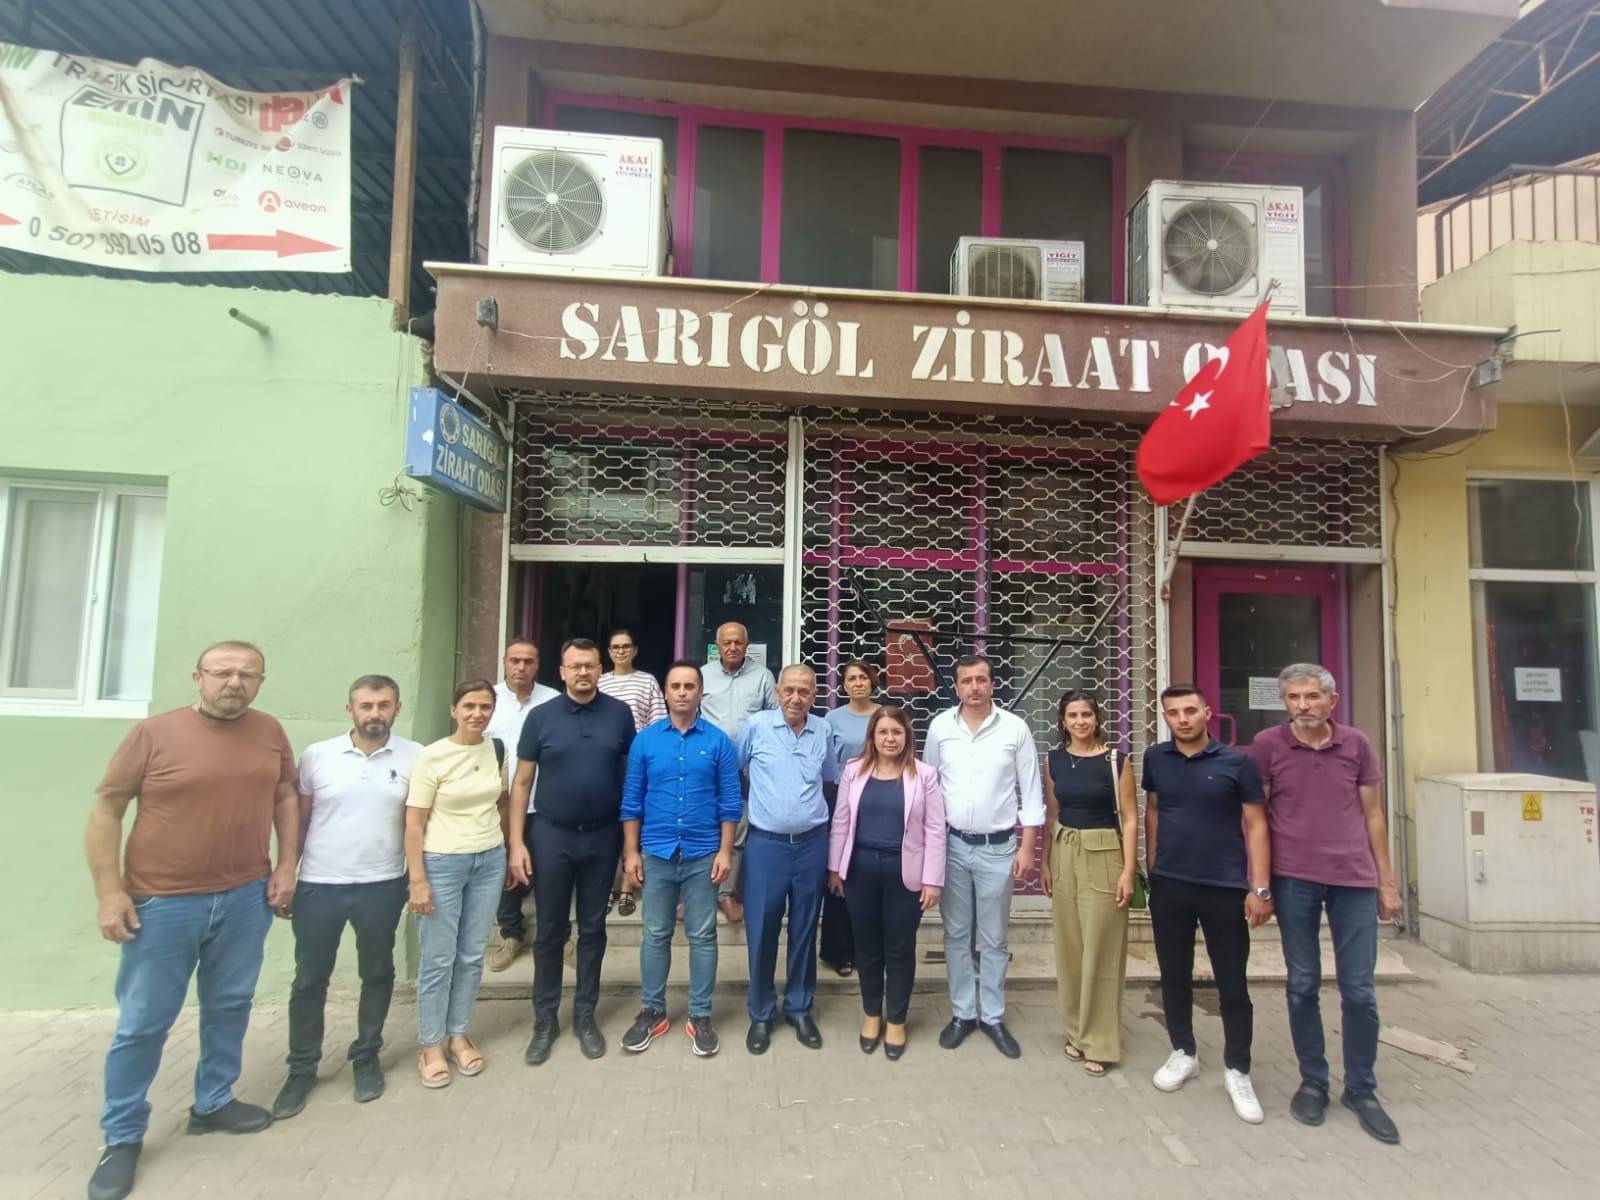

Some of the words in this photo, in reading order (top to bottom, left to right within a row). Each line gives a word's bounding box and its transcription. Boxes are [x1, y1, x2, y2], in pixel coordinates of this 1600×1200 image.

[206, 151, 247, 174] HDI
[262, 164, 323, 183] NEOVA
[284, 199, 327, 214] aveon
[1267, 202, 1294, 211] AKAI
[29, 216, 41, 238] 0
[100, 232, 138, 256] 392
[137, 233, 165, 256] 05
[171, 231, 202, 255] 08
[559, 300, 874, 379] SARIGÖL
[911, 310, 1160, 393] ZİRAAT
[1183, 342, 1378, 407] OASI
[435, 443, 477, 487] ZİRAAT
[1578, 806, 1594, 816] TR
